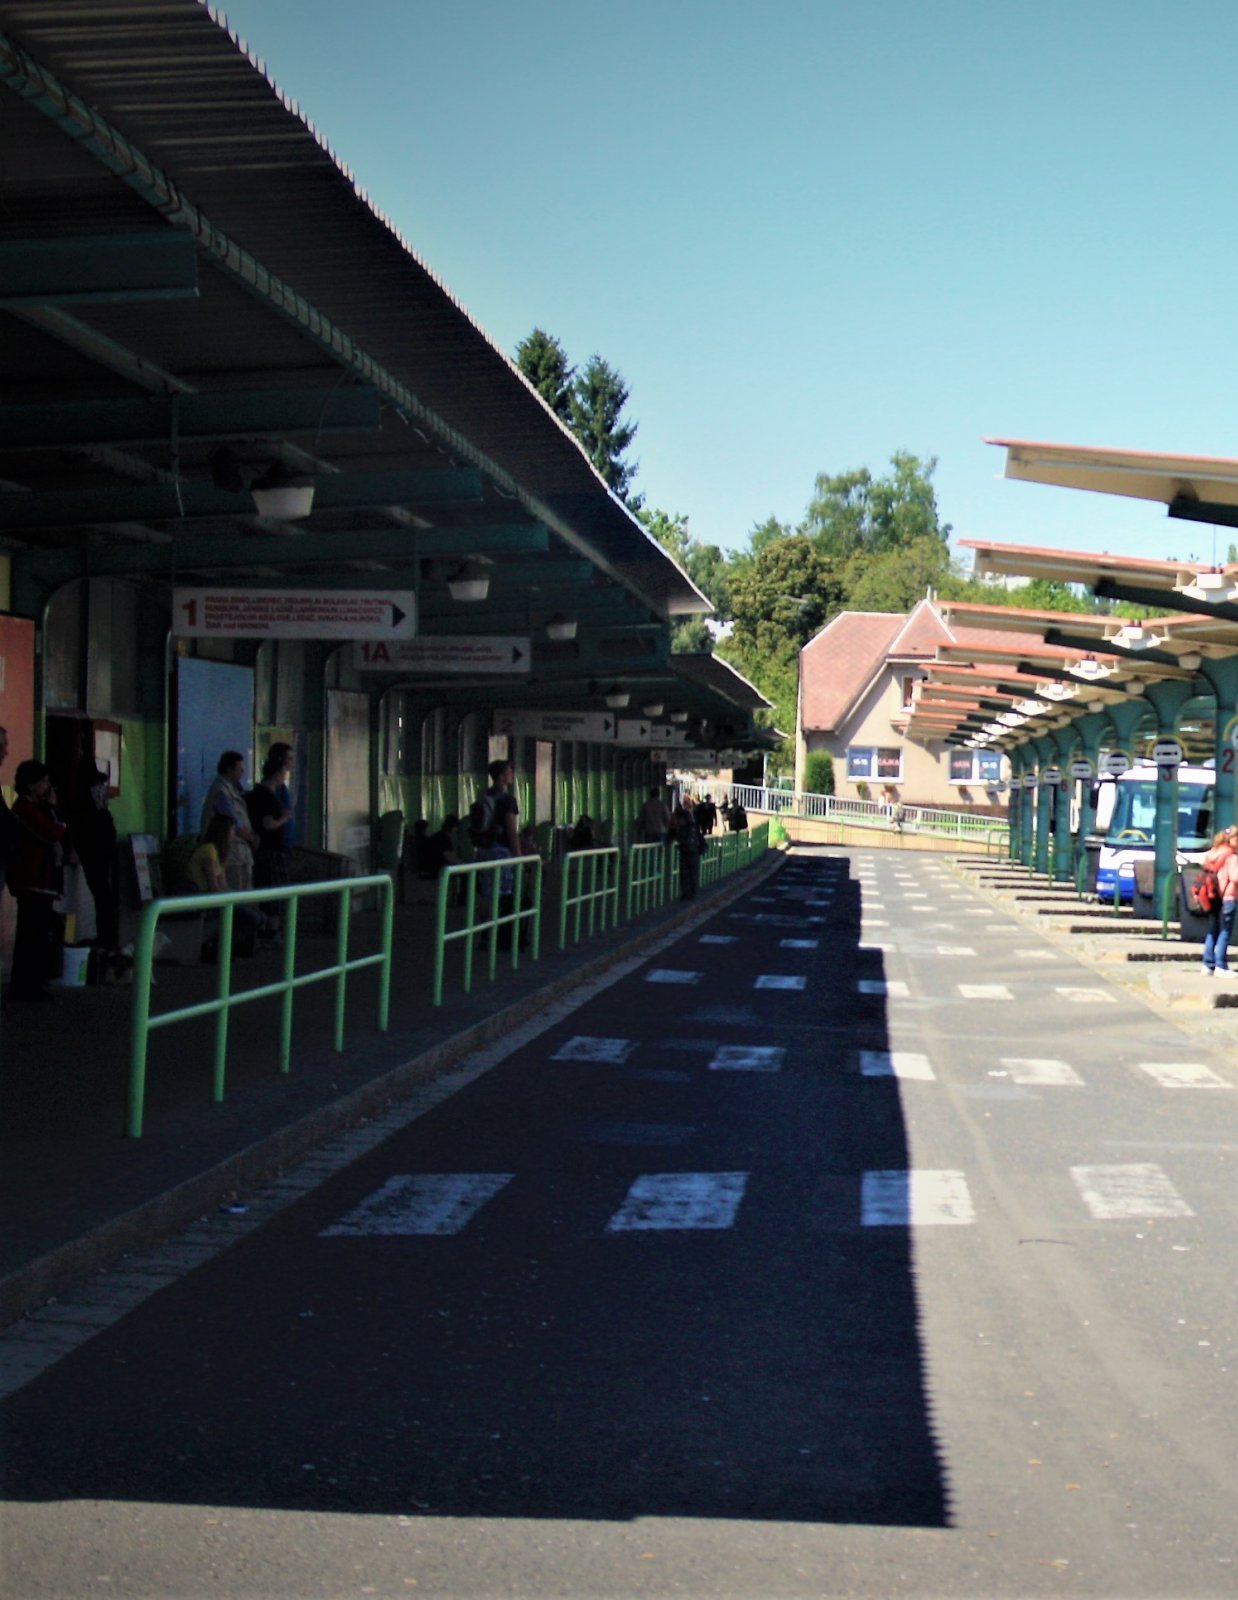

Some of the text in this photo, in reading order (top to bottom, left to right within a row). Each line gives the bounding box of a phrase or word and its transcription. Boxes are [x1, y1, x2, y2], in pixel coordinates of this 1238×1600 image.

[182, 598, 197, 627] 1
[361, 641, 391, 663] 1A
[1222, 748, 1235, 774] 2
